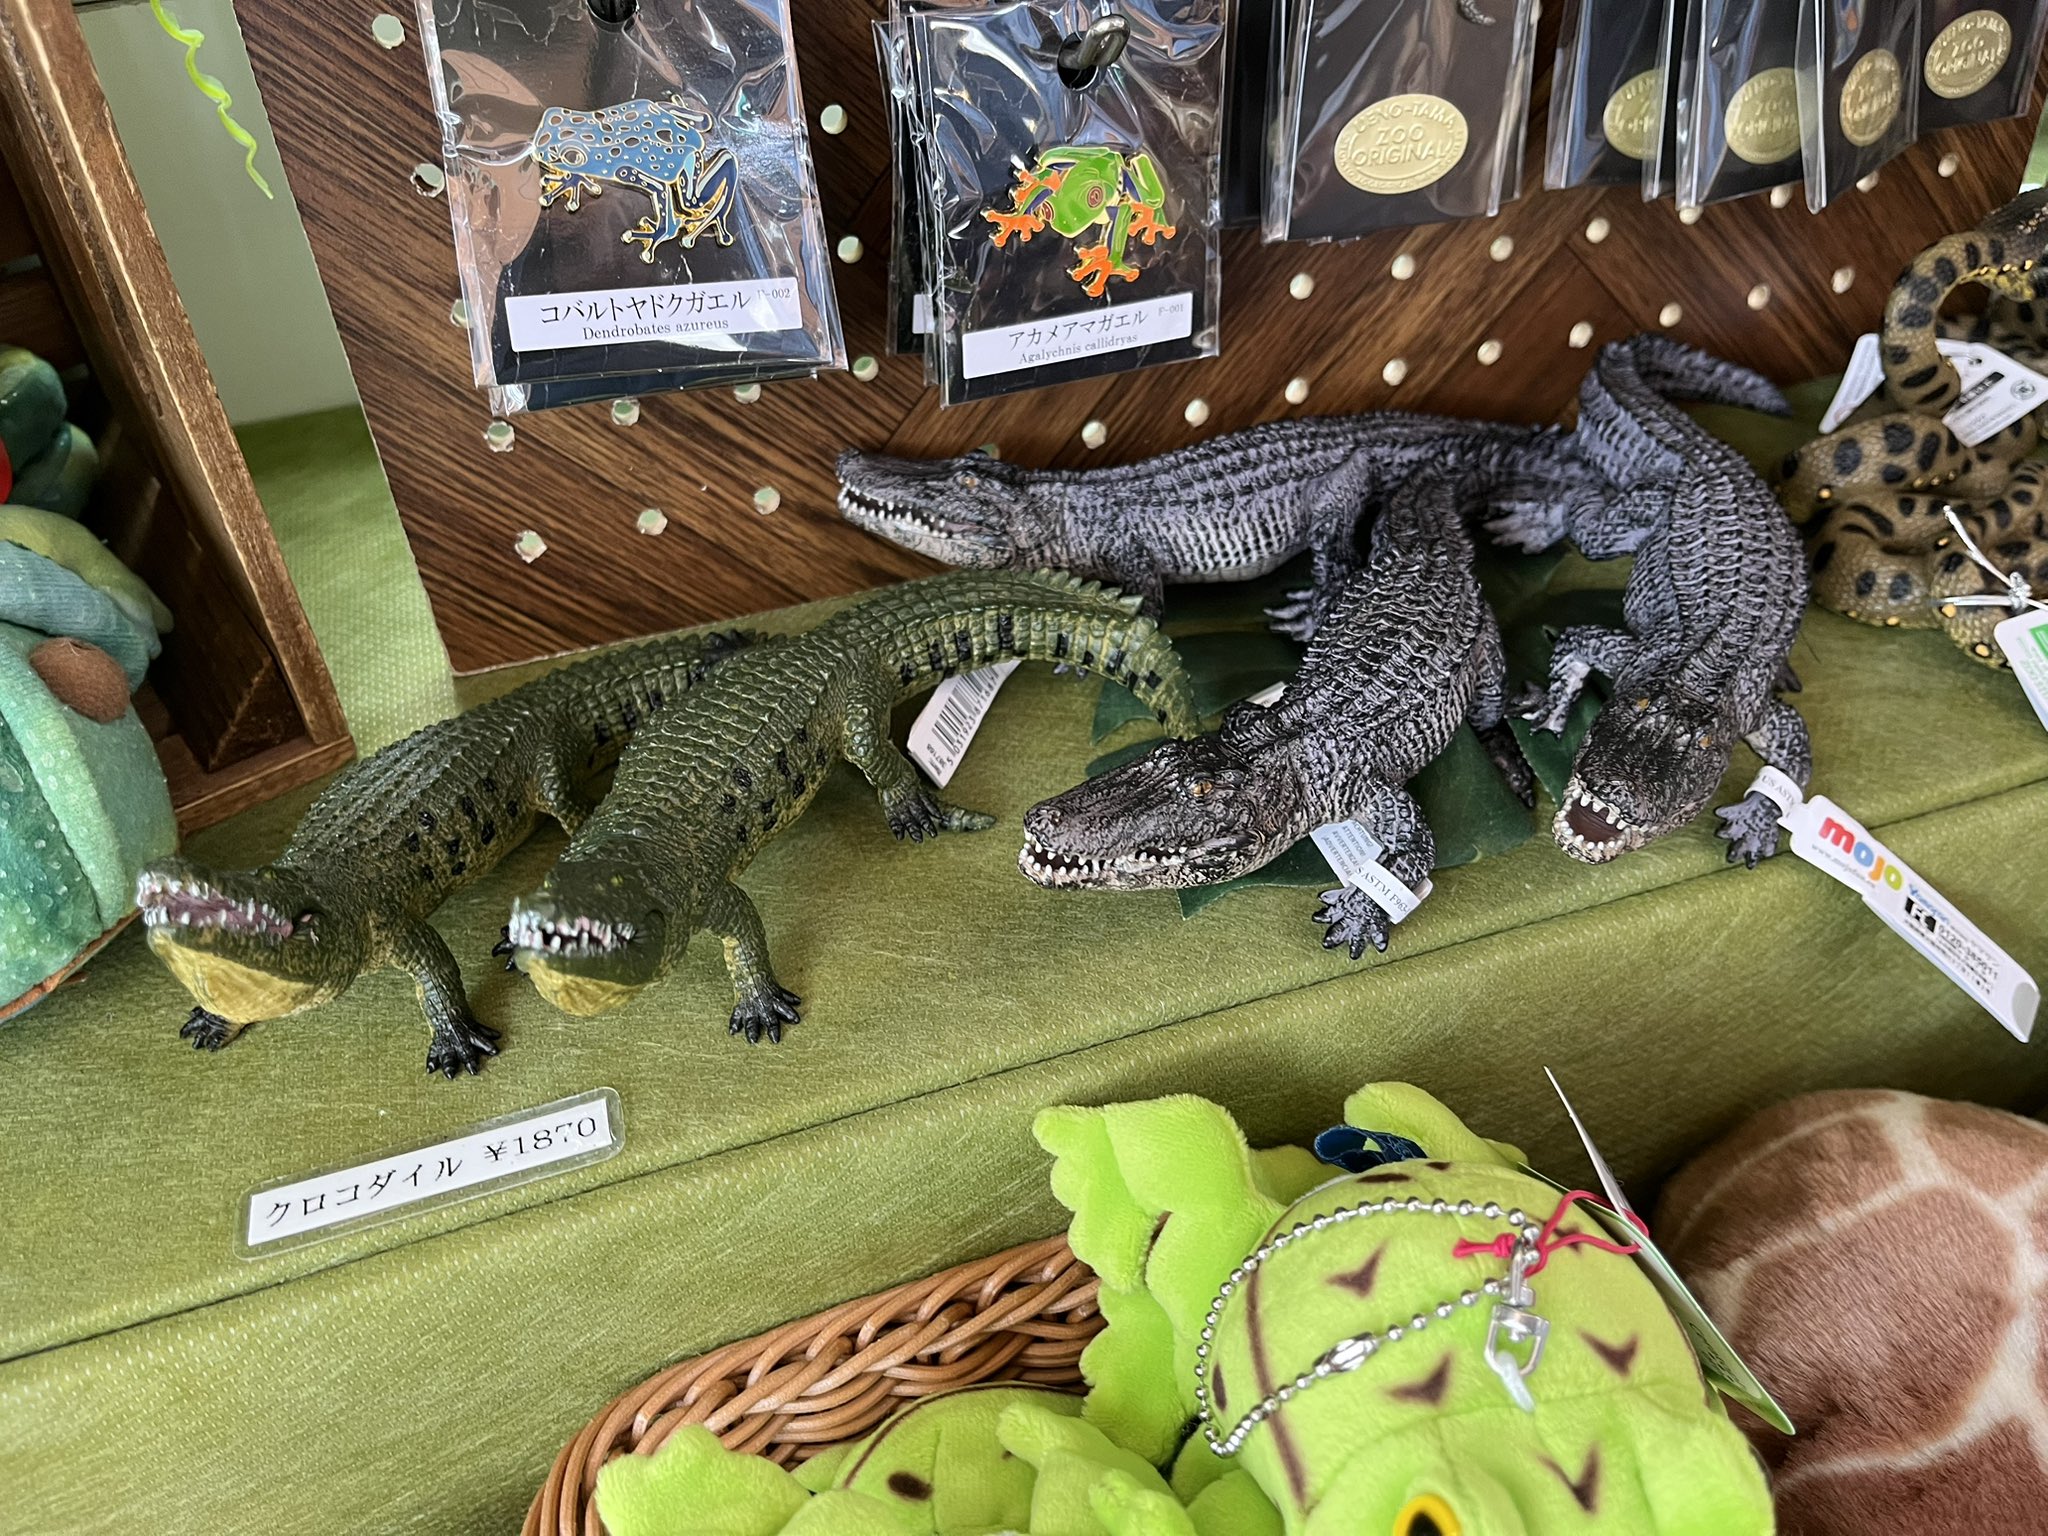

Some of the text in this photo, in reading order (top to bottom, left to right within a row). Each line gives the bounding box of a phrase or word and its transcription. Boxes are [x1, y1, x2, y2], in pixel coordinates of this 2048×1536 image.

[1376, 122, 1424, 146] ZOO
[1352, 138, 1447, 166] ORIGINAL
[540, 290, 751, 324] コバルトヤドクガエル
[583, 318, 729, 341] Dendrobates azureus
[1008, 310, 1148, 351] アカメアマガエル
[1019, 333, 1138, 364] Agalychnis callidryas
[1819, 817, 1903, 890] mojo
[1361, 871, 1392, 896] ASTM
[265, 1116, 597, 1228] クロコダイル ¥1870
